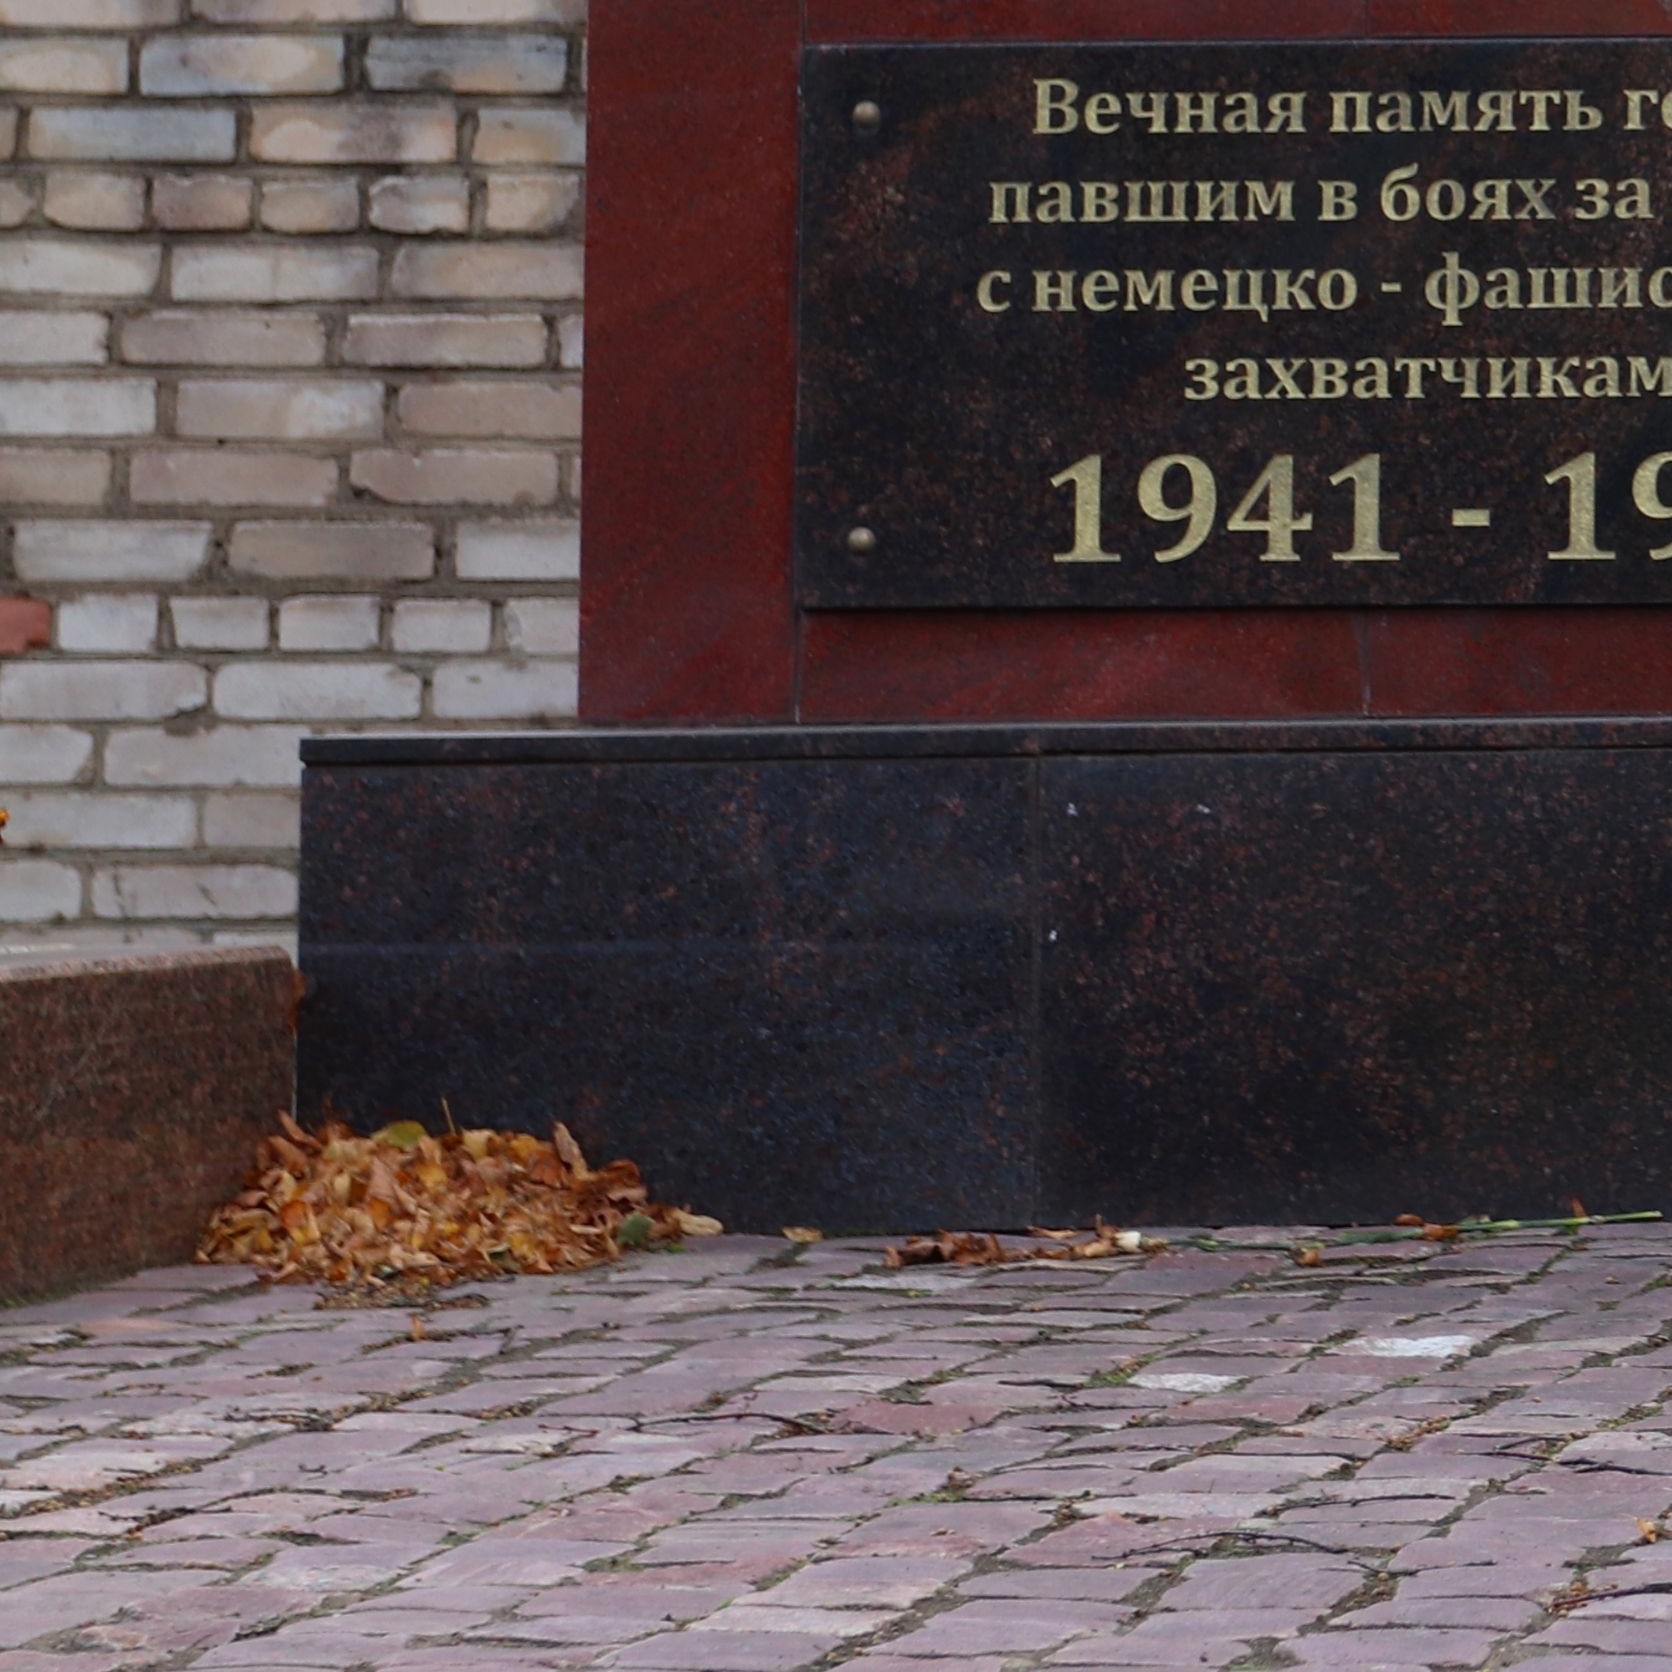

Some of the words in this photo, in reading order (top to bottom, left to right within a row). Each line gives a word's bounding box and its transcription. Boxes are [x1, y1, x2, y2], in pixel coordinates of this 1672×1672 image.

[1031, 78, 1306, 135] Вечная
[1328, 89, 1603, 133] память
[988, 180, 1294, 224] павшим
[1318, 180, 1358, 222] в
[1379, 162, 1556, 222] боях
[1574, 177, 1653, 221] за
[976, 269, 1012, 313] с
[1032, 268, 1358, 323] немецко
[1049, 452, 1402, 564] 1941
